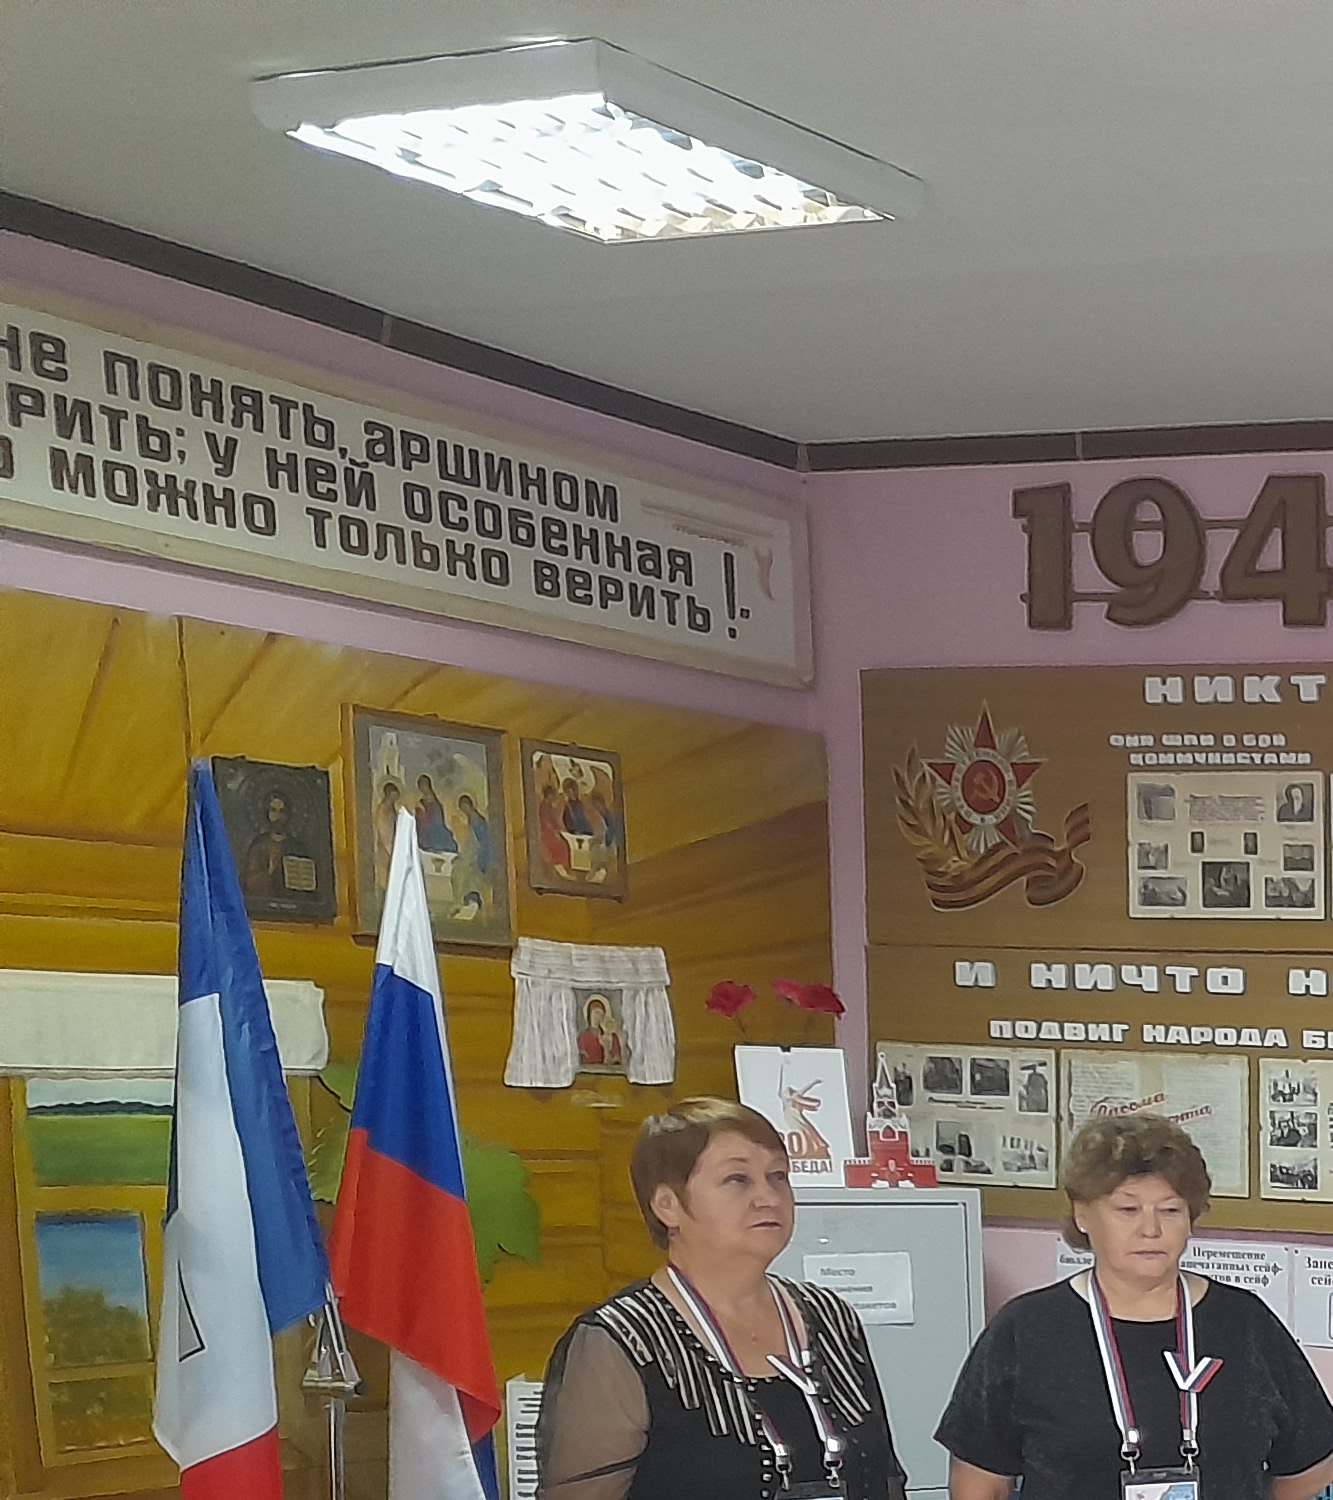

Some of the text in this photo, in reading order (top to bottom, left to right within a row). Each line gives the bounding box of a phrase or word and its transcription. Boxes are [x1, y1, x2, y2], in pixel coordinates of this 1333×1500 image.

[362, 418, 619, 524] аршином
[49, 445, 277, 537] можно
[305, 506, 510, 588] только
[203, 429, 239, 479] у
[264, 445, 377, 512] ней
[402, 480, 693, 588] особенная
[953, 961, 998, 988] И
[1029, 962, 1248, 998] НИЧТО
[988, 1018, 1131, 1045] ПОДВИГ
[1141, 1022, 1288, 1049] НАРОДА
[791, 1159, 834, 1174] БЕДА!
[1180, 1259, 1251, 1273] апечатанных
